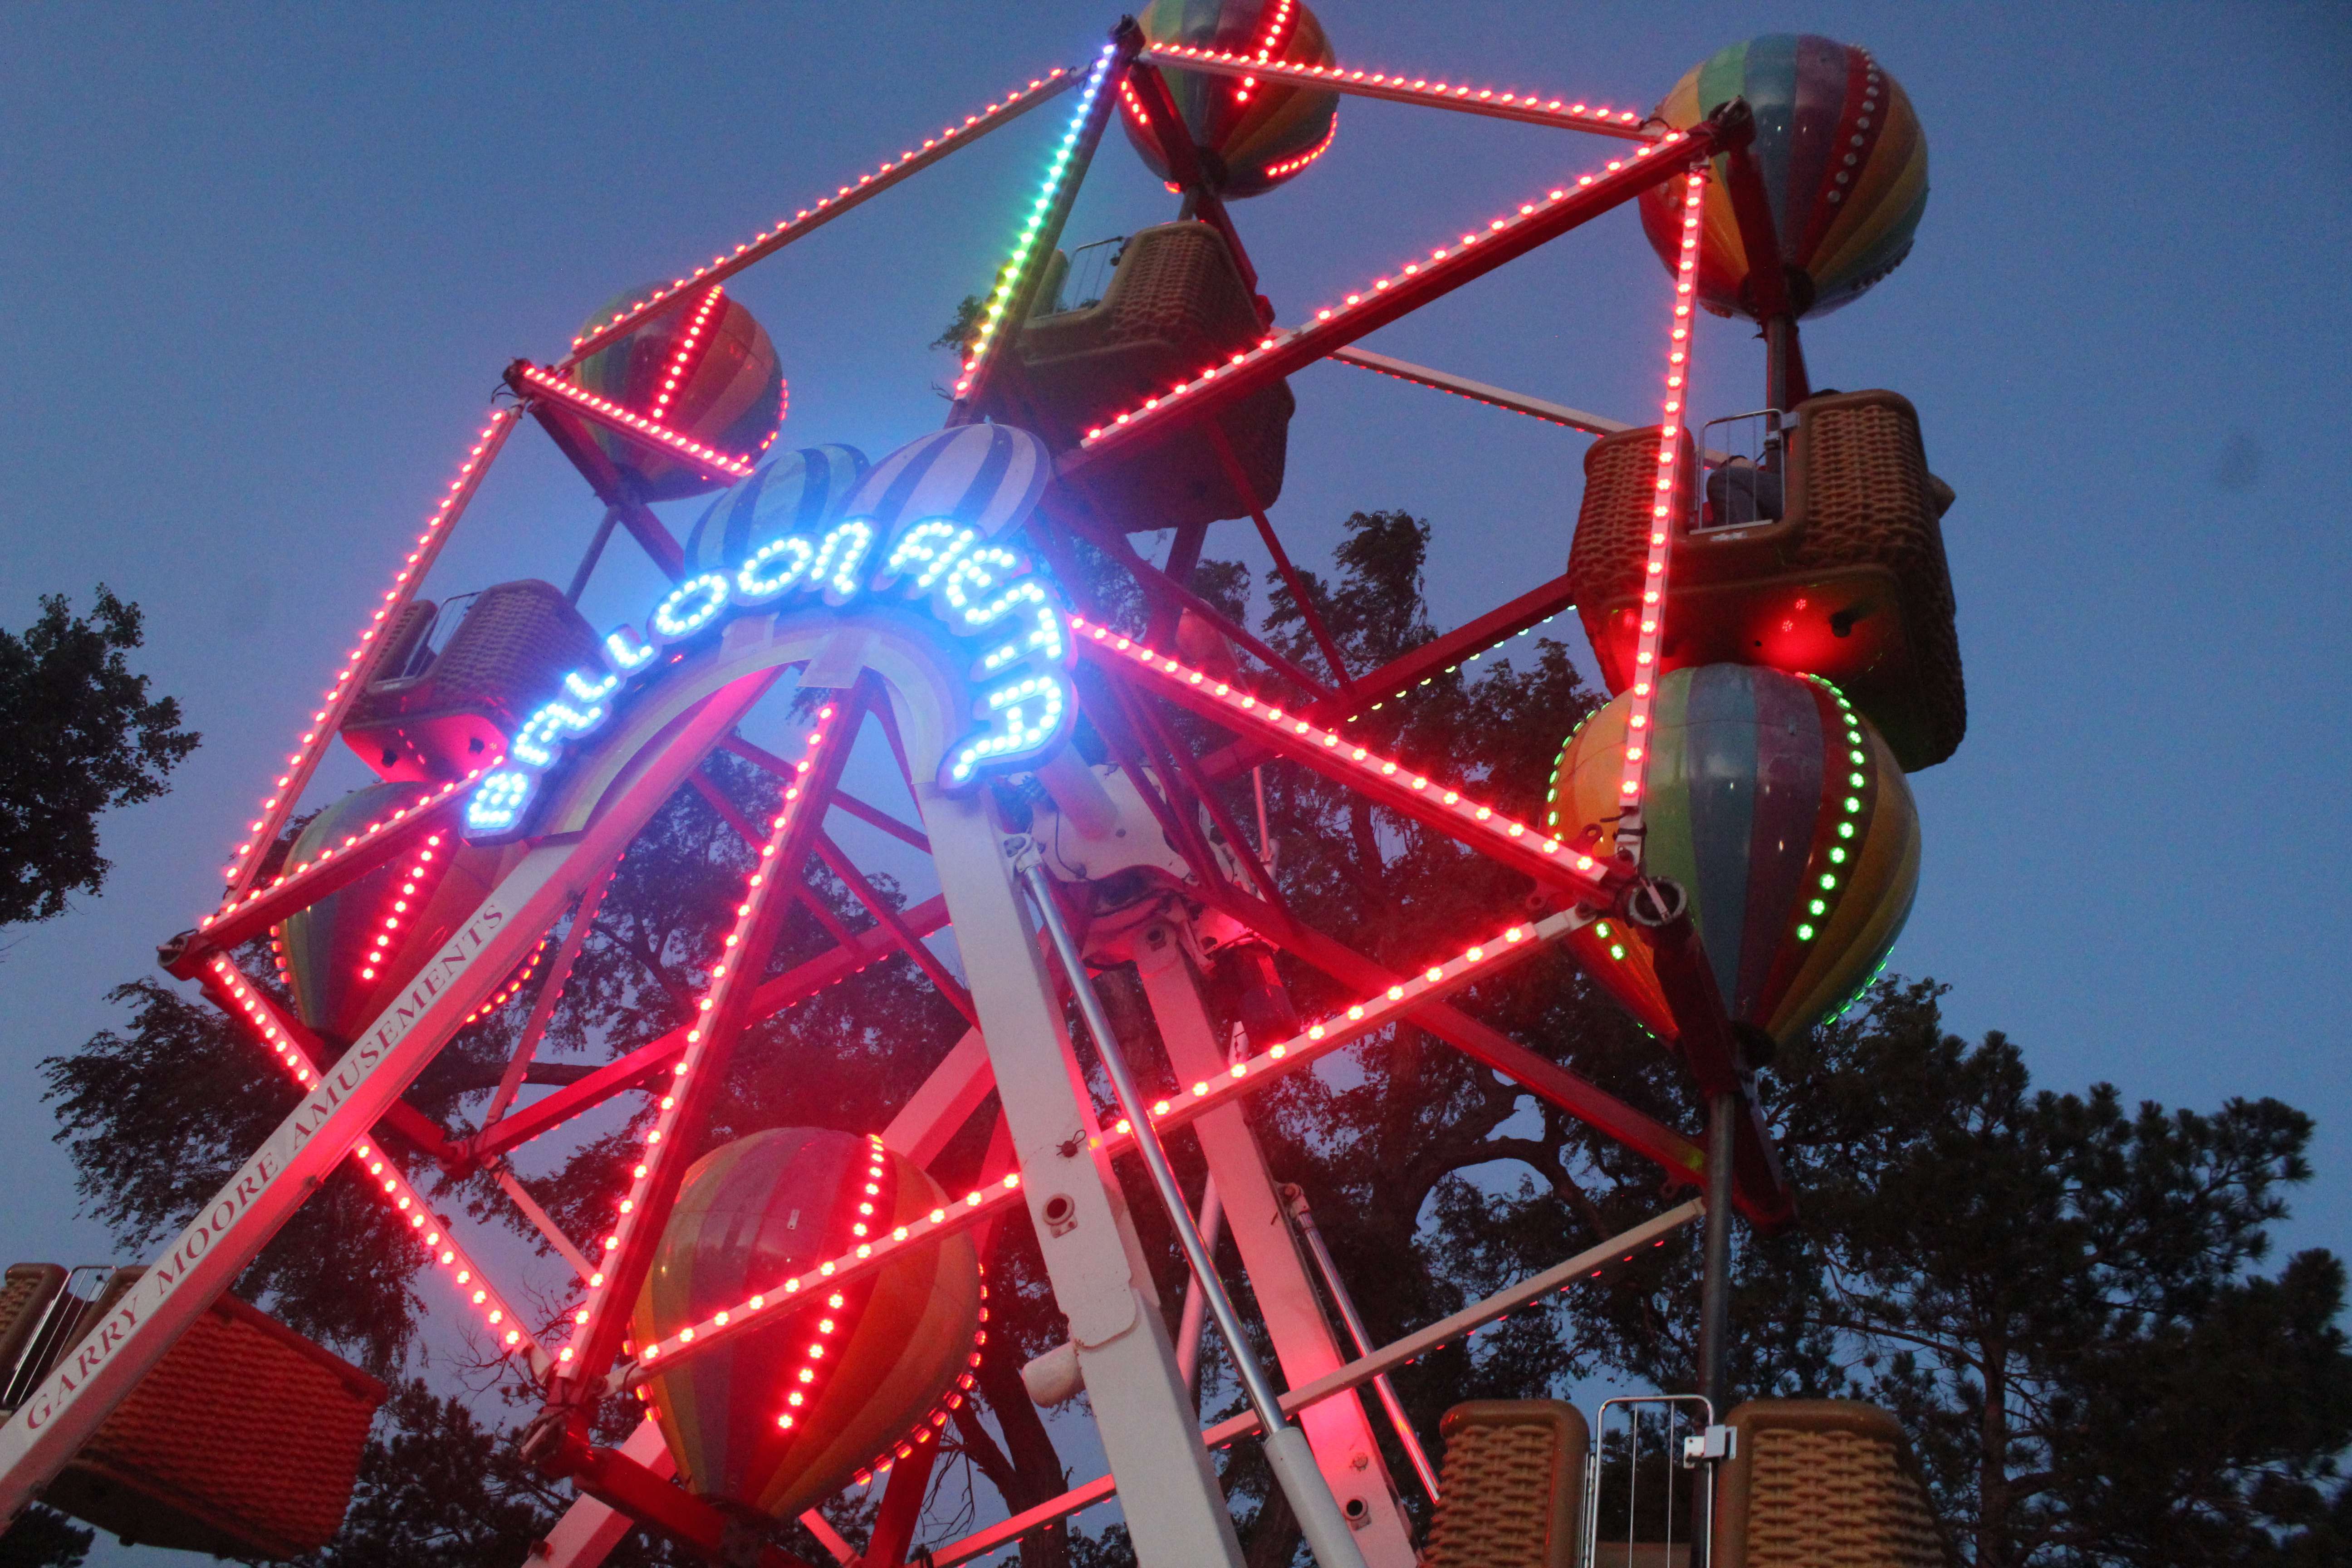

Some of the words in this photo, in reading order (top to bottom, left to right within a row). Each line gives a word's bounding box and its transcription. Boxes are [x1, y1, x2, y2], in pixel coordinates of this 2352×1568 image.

[466, 518, 875, 831] BALLOON
[27, 1294, 138, 1430] GARRY
[156, 1152, 279, 1295] MOORE
[293, 904, 503, 1150] AMUSEMENTS
